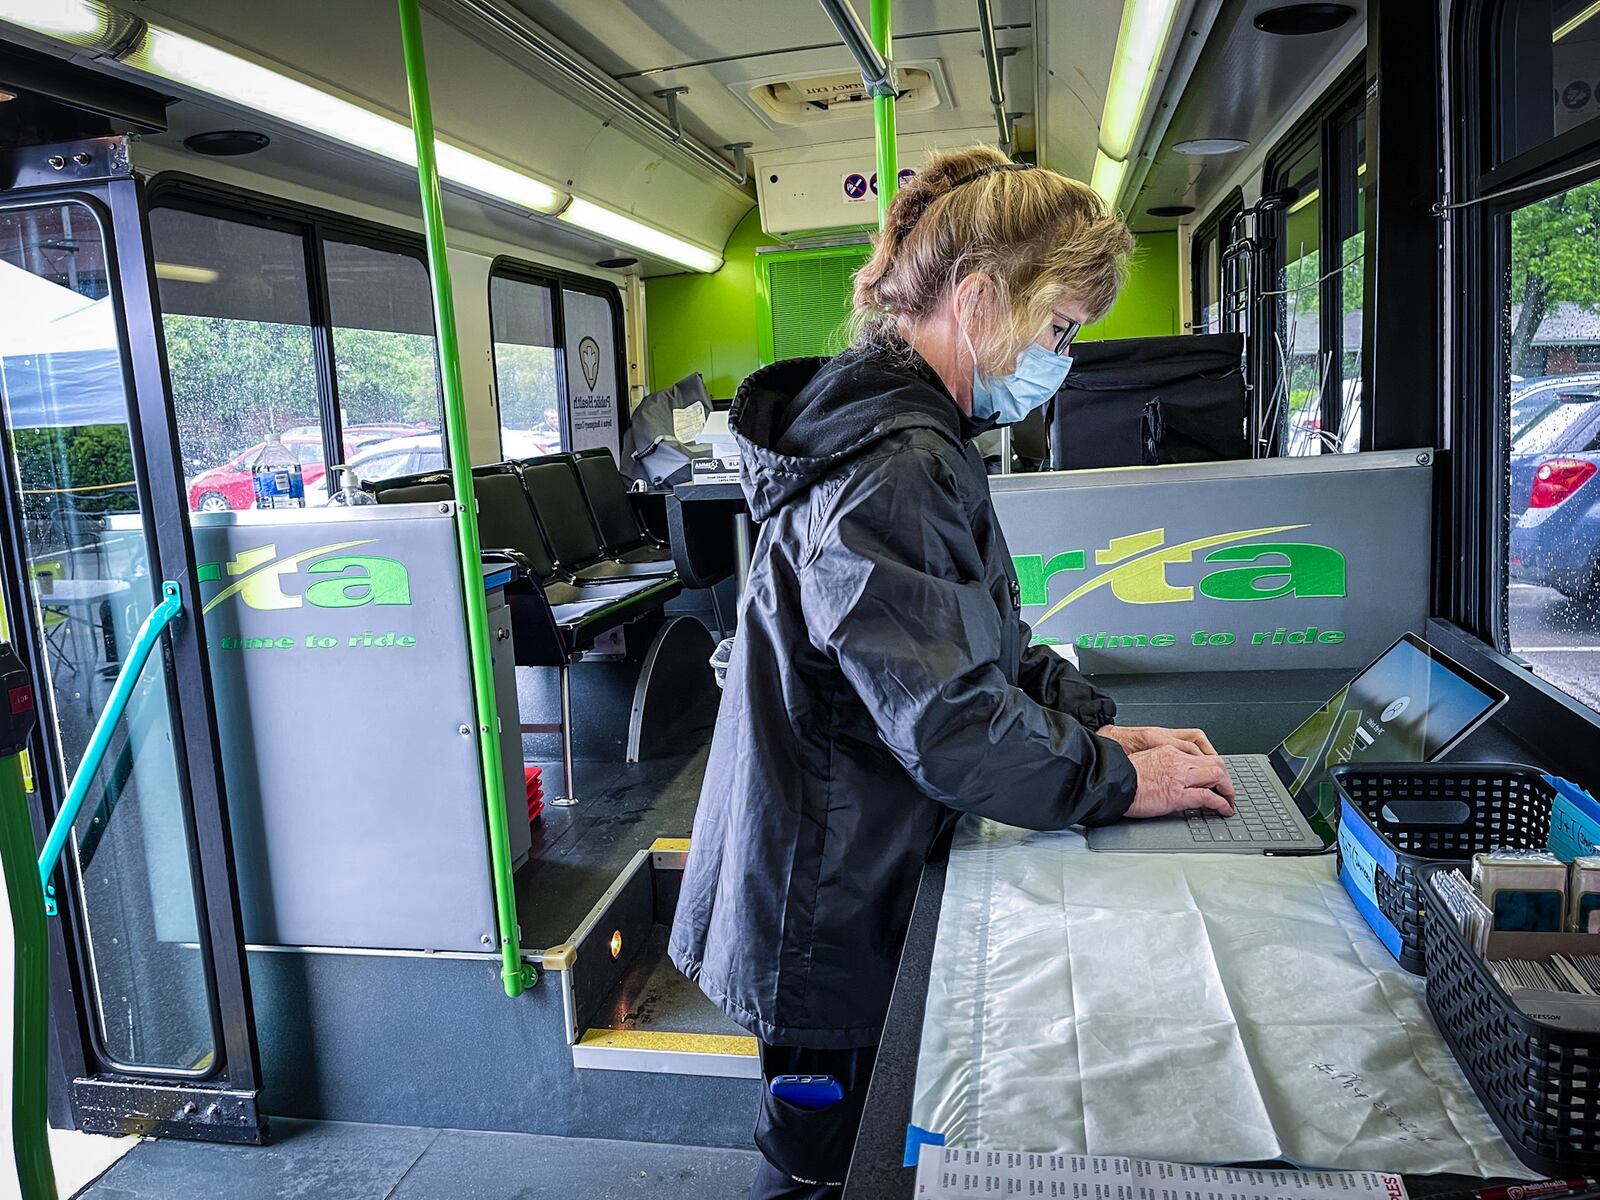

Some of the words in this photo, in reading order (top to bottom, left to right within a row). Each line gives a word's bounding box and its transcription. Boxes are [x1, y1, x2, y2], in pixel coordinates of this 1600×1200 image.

[806, 86, 829, 94] EXIT
[1011, 526, 1347, 606] rta
[220, 633, 295, 650] time
[304, 632, 338, 648] to
[348, 630, 417, 648] ride
[1076, 631, 1177, 649] time
[1190, 630, 1237, 647] to
[1251, 626, 1347, 646] ride
